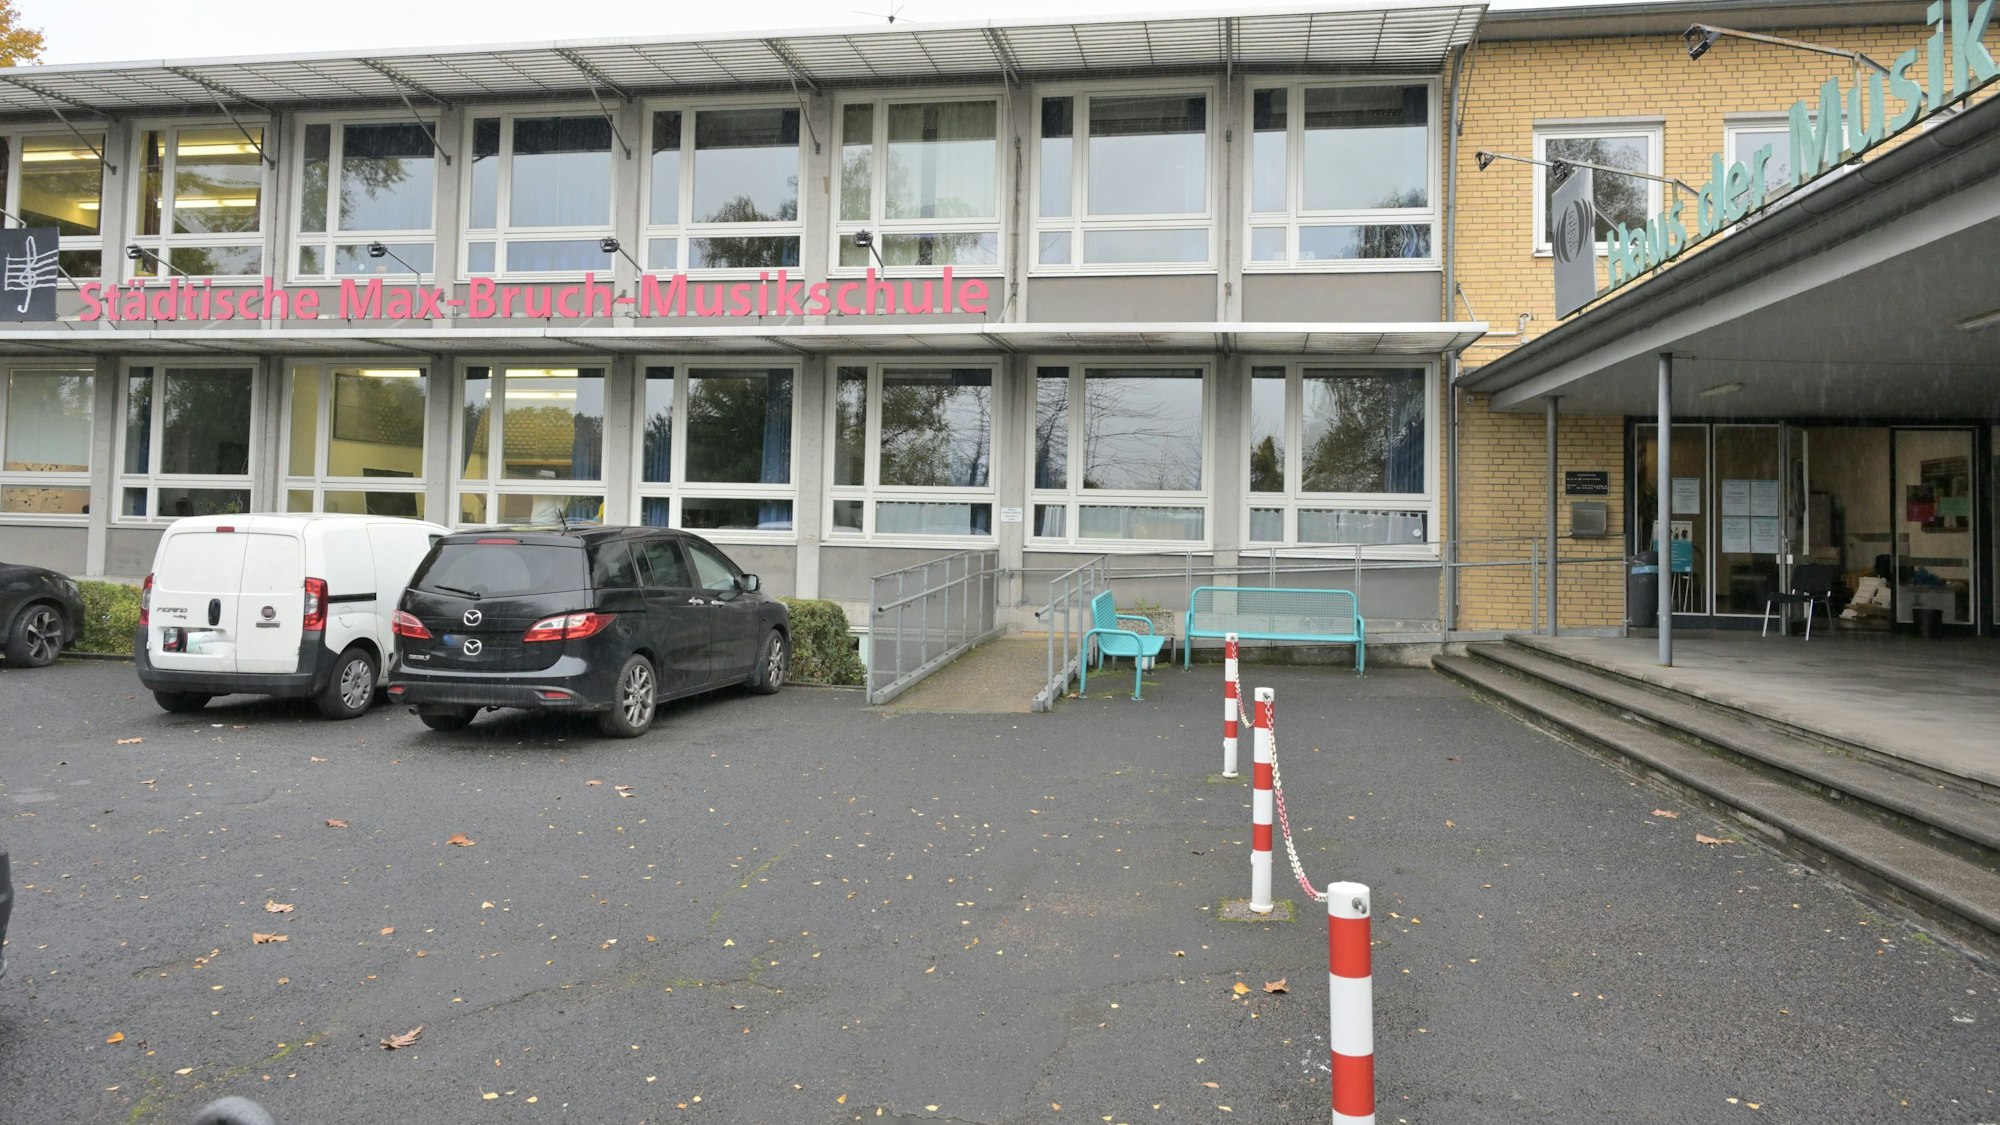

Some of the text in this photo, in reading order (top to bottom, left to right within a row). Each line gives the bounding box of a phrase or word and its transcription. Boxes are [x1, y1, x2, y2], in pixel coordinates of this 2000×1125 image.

[1607, 200, 1687, 290] Haus
[1697, 143, 1773, 238] der
[1788, 0, 2000, 189] Musik
[79, 266, 989, 321] Städtische Max-Bruch-Musikschule
